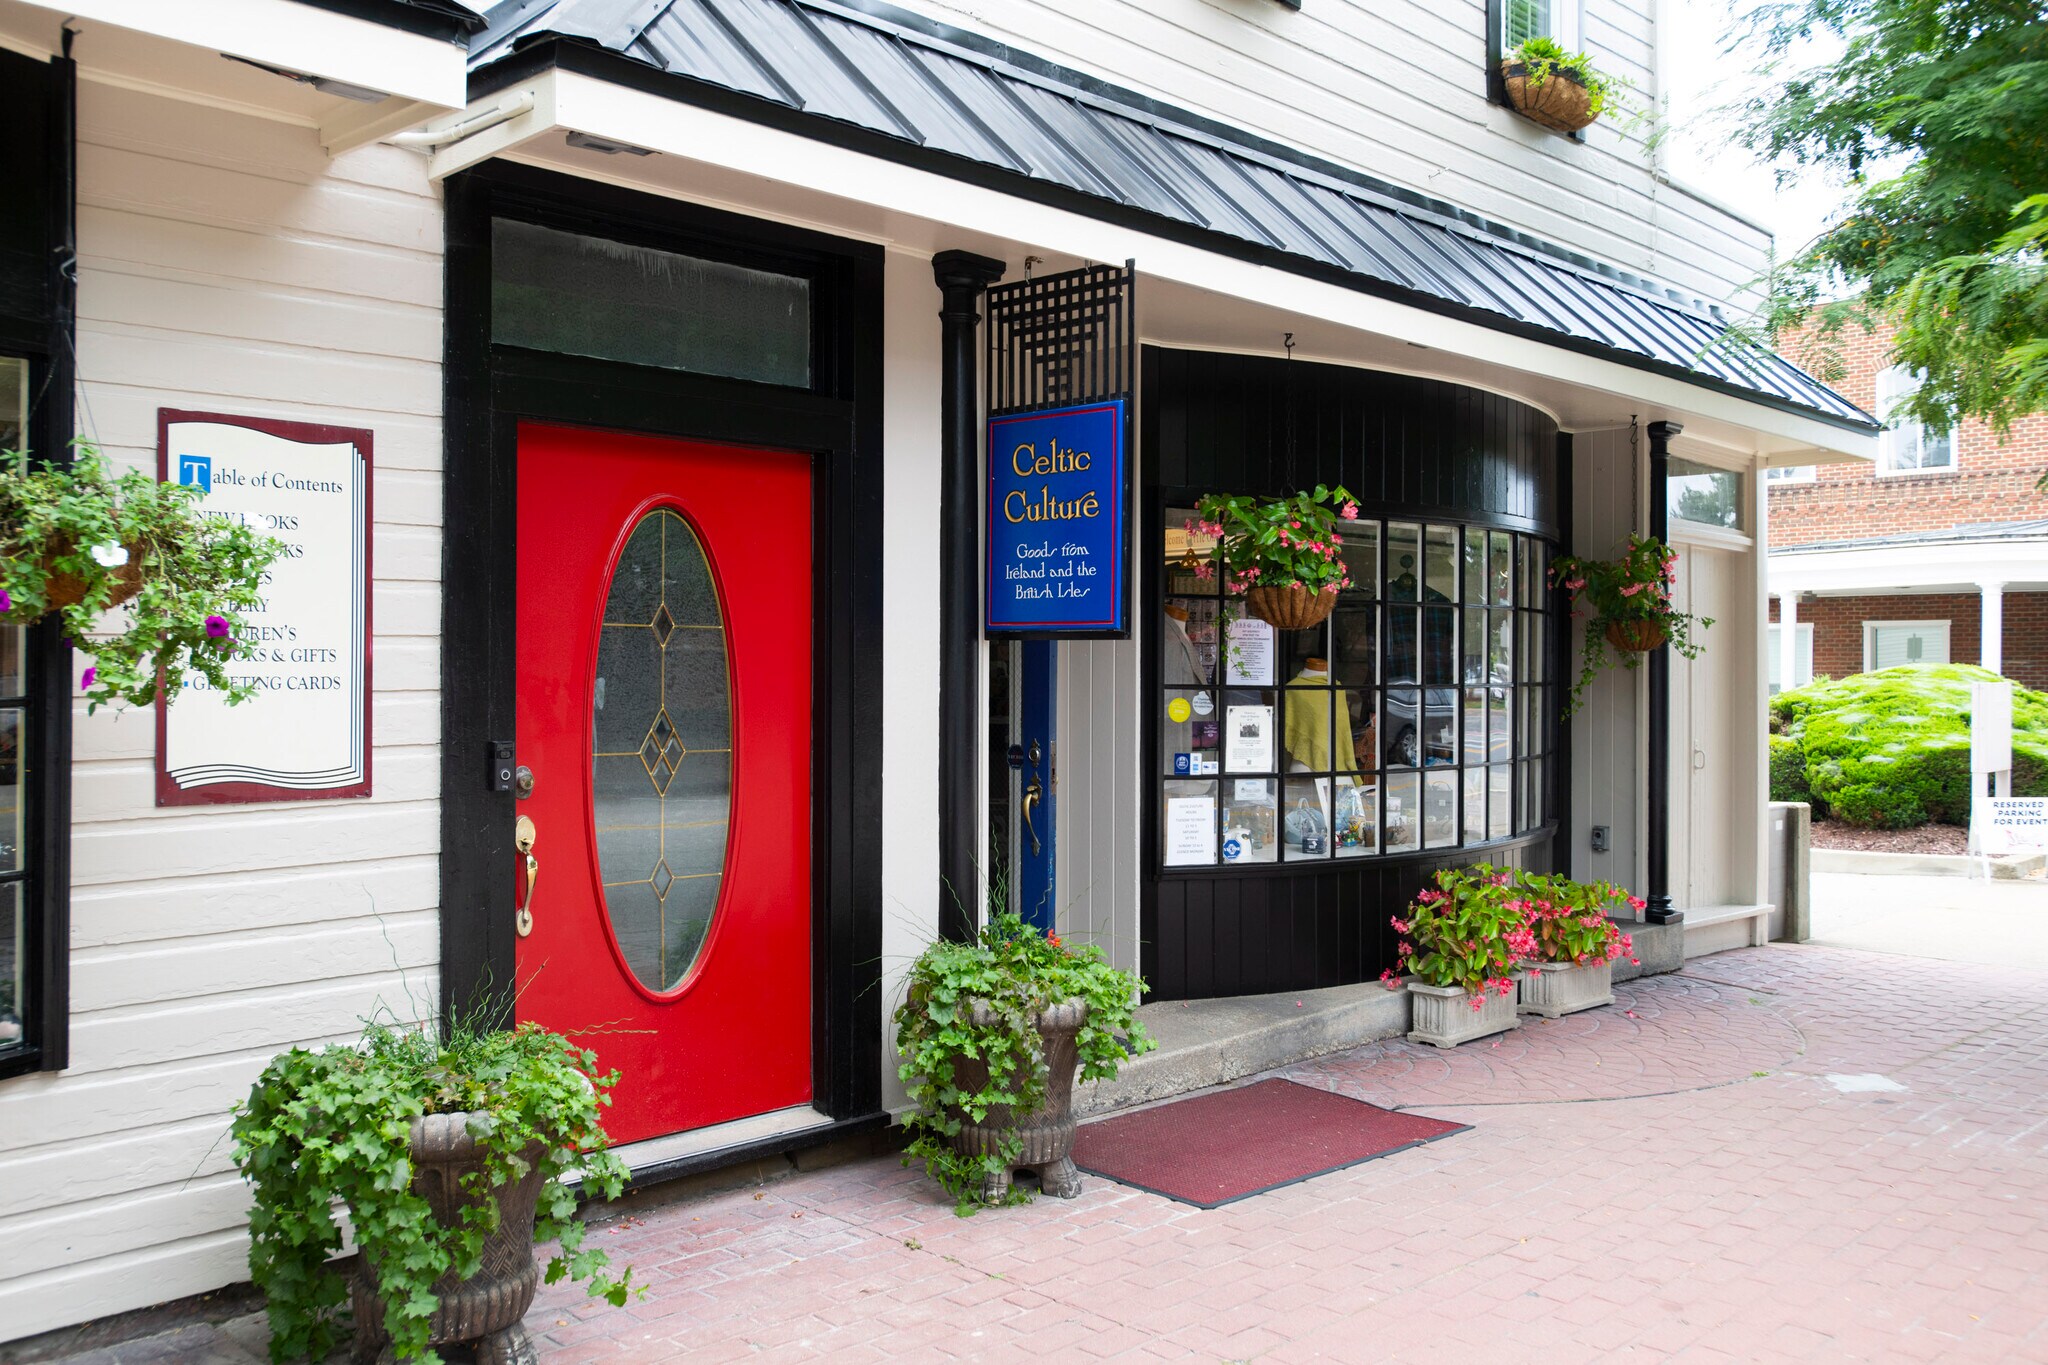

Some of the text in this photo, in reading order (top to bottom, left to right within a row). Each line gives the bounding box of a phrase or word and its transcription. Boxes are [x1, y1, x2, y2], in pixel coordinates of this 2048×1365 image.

[1012, 437, 1092, 478] Celtic
[183, 461, 343, 494] Table of Contents
[1003, 484, 1100, 524] Culture
[1016, 540, 1090, 559] Goods from
[1005, 559, 1097, 580] Ireland and the
[1015, 581, 1091, 600] British Isles
[237, 624, 297, 641] DREN'S
[271, 648, 287, 663] &
[290, 648, 337, 663] GIFTS
[286, 676, 341, 691] CARDS
